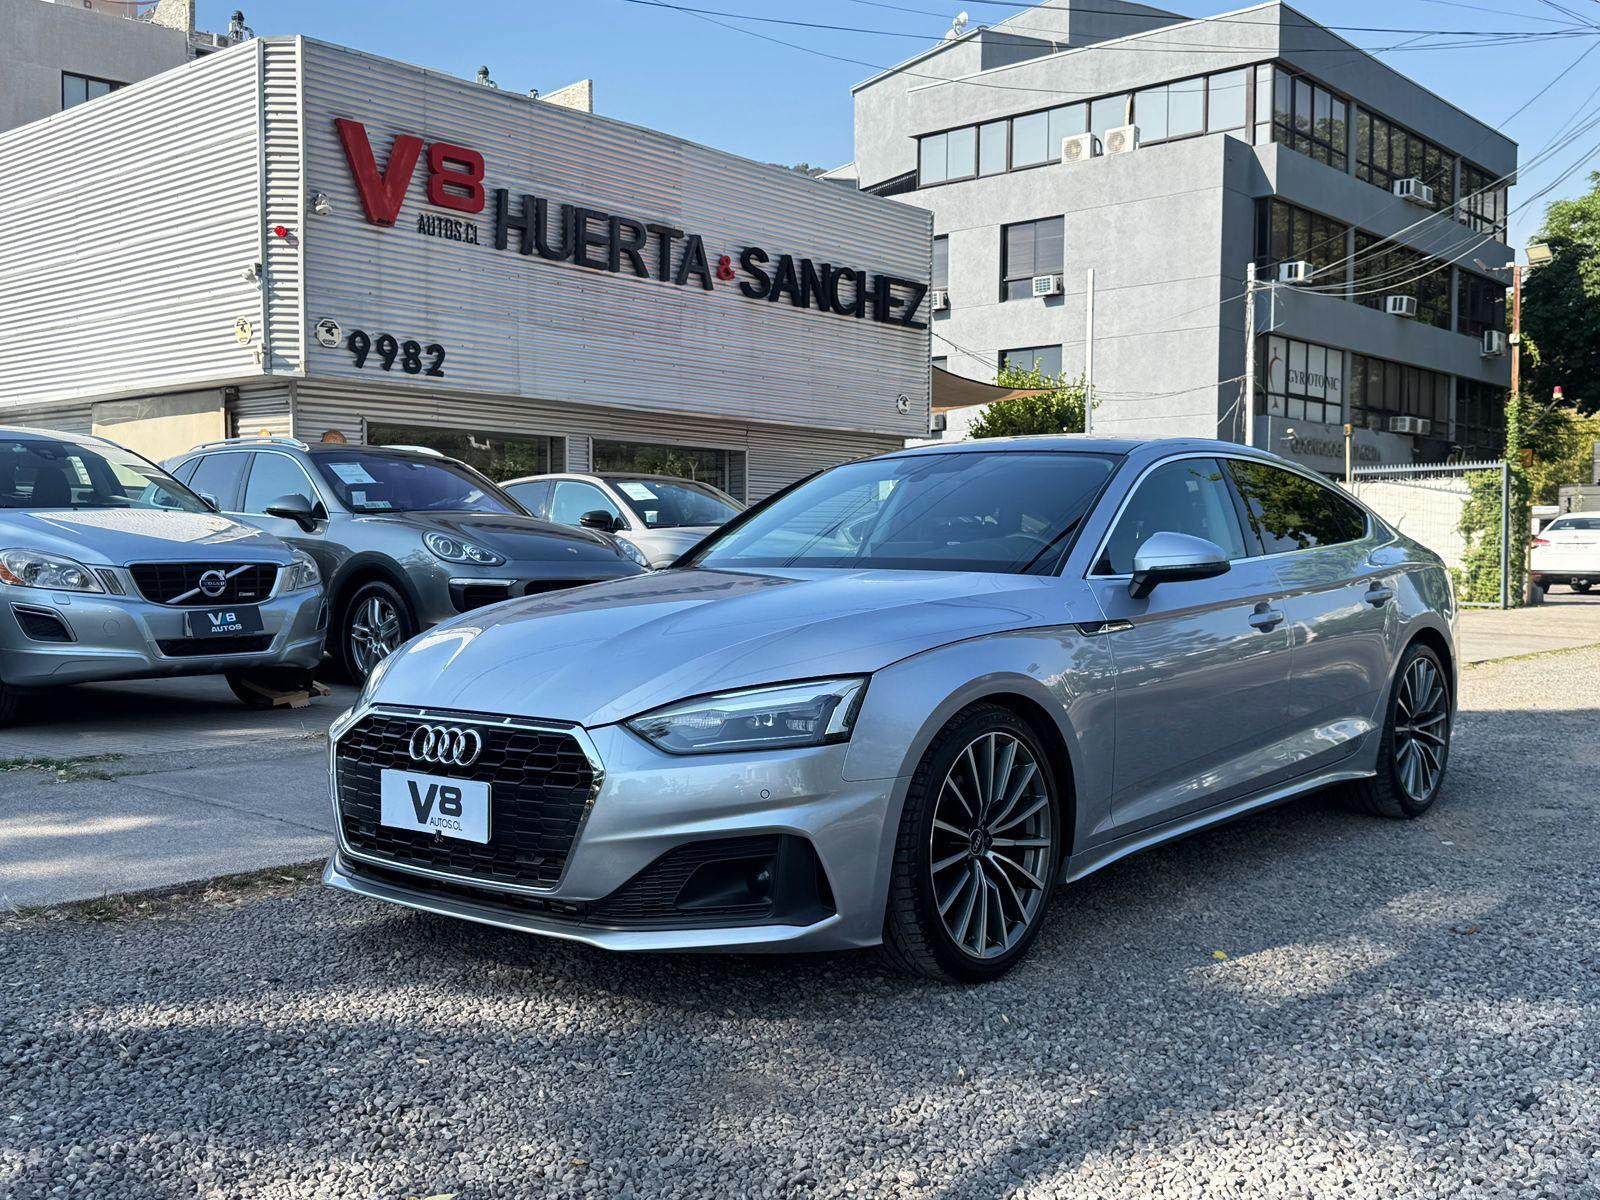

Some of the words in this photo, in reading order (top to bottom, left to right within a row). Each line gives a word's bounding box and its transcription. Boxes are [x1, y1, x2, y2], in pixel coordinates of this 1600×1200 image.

[335, 117, 485, 228] V8
[417, 213, 480, 246] AUTOS.CL
[495, 188, 714, 291] HUERTA
[716, 255, 736, 281] &
[739, 247, 928, 329] SANCHEZ
[347, 329, 446, 377] 9982
[1287, 368, 1340, 391] GYROTONIC
[211, 623, 243, 633] AUTOS
[407, 780, 463, 825] V8
[429, 817, 463, 832] AUTOS.CL
